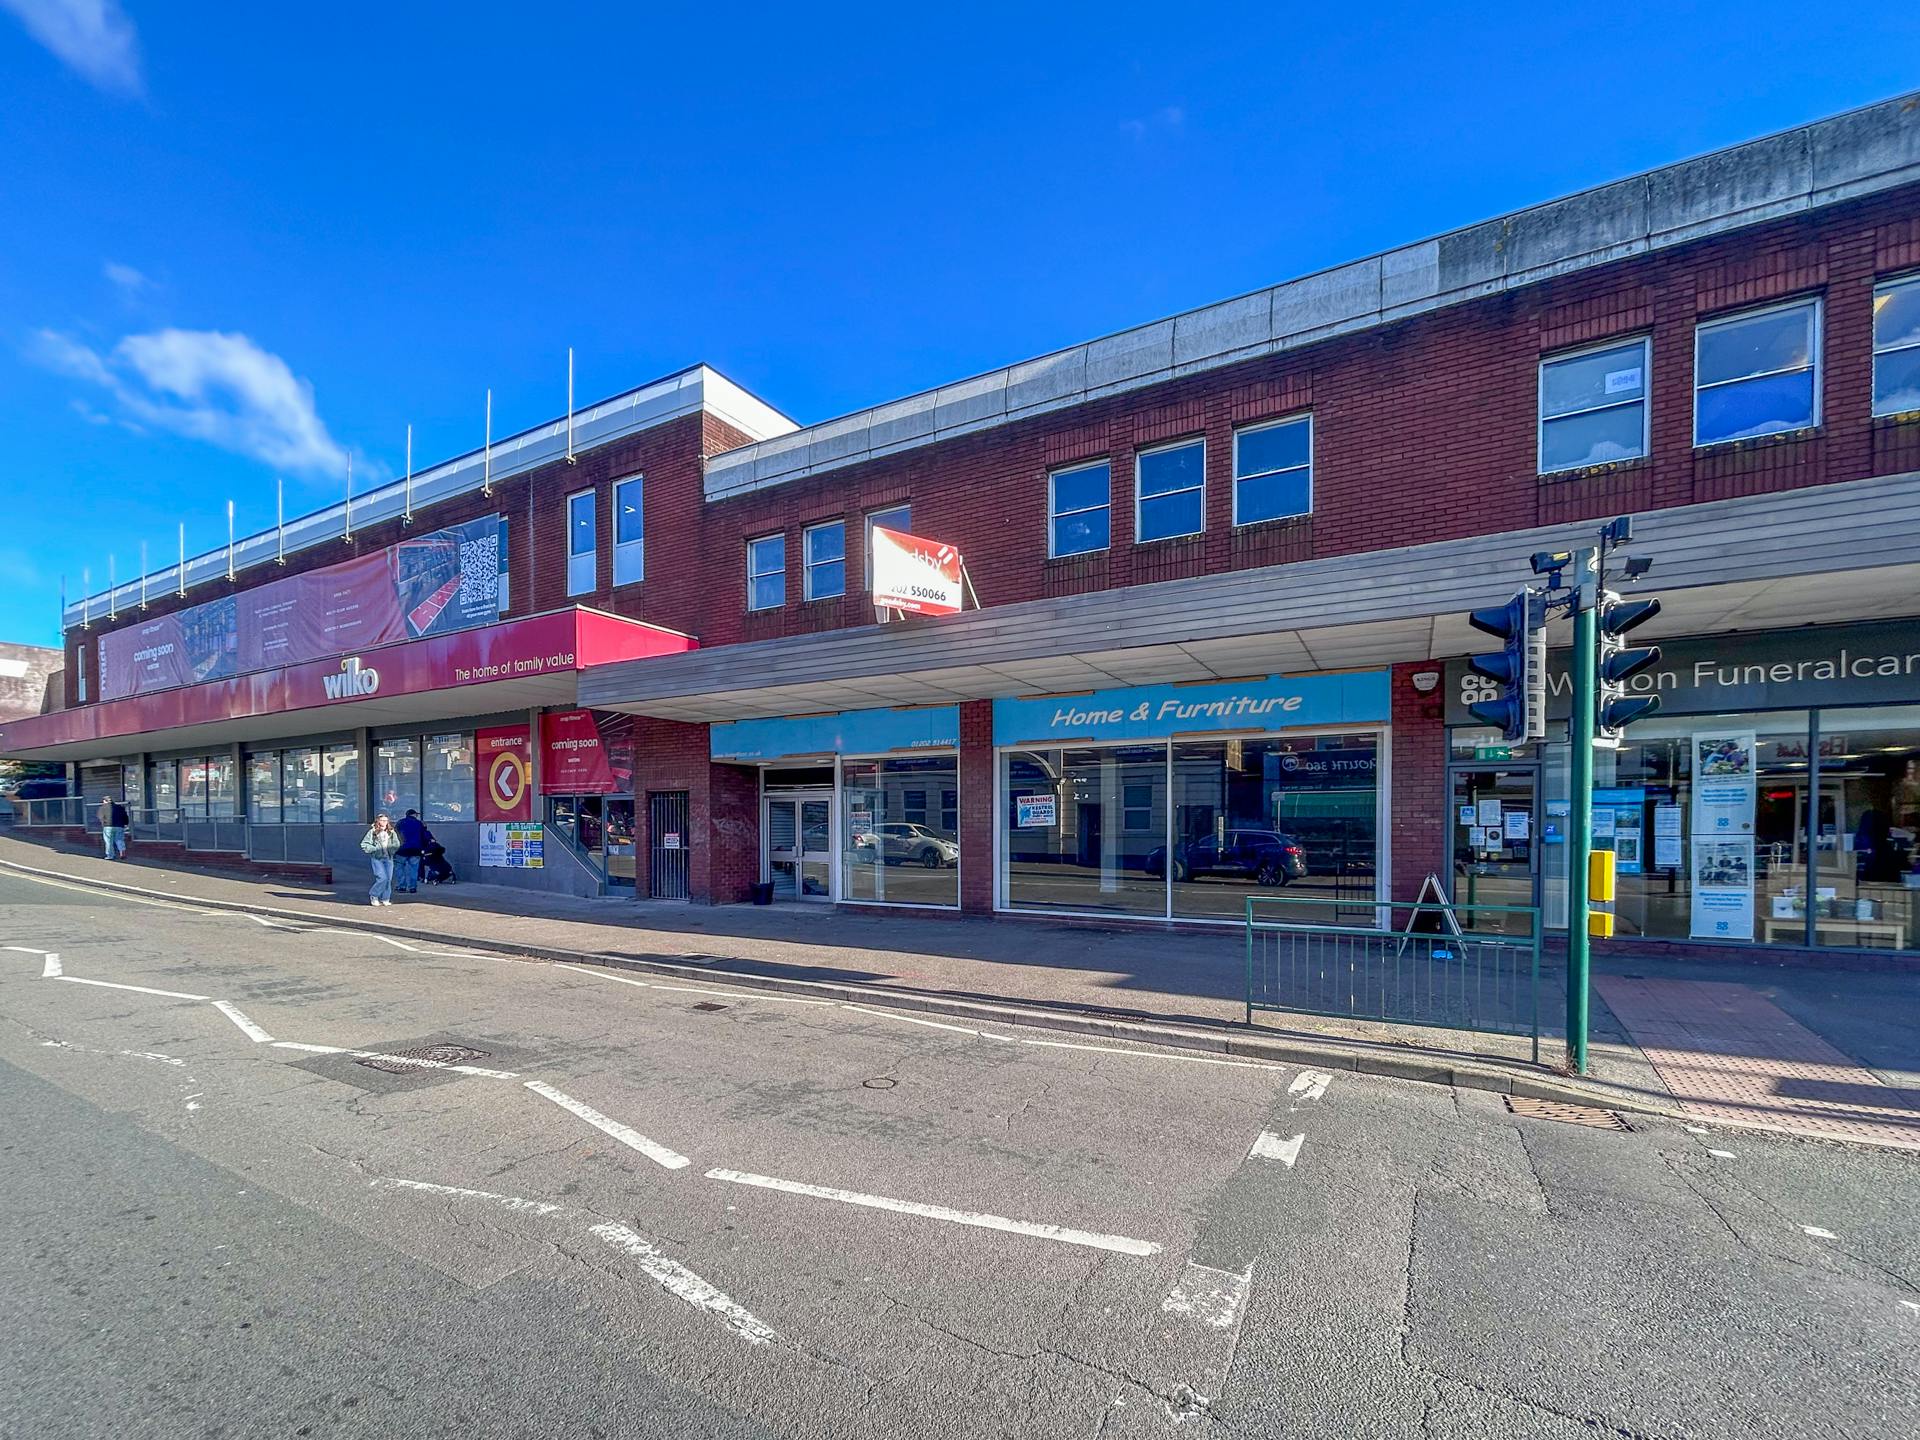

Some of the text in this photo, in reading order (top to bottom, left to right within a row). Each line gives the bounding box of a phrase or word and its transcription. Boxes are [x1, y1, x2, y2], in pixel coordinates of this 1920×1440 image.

[911, 585, 946, 602] 550066
[134, 643, 174, 661] coming soon
[455, 653, 575, 681] The home of family value
[323, 657, 379, 699] wilko
[1051, 696, 1303, 728] Home & Furniture
[491, 737, 522, 747] entrance
[552, 738, 598, 751] coming soon
